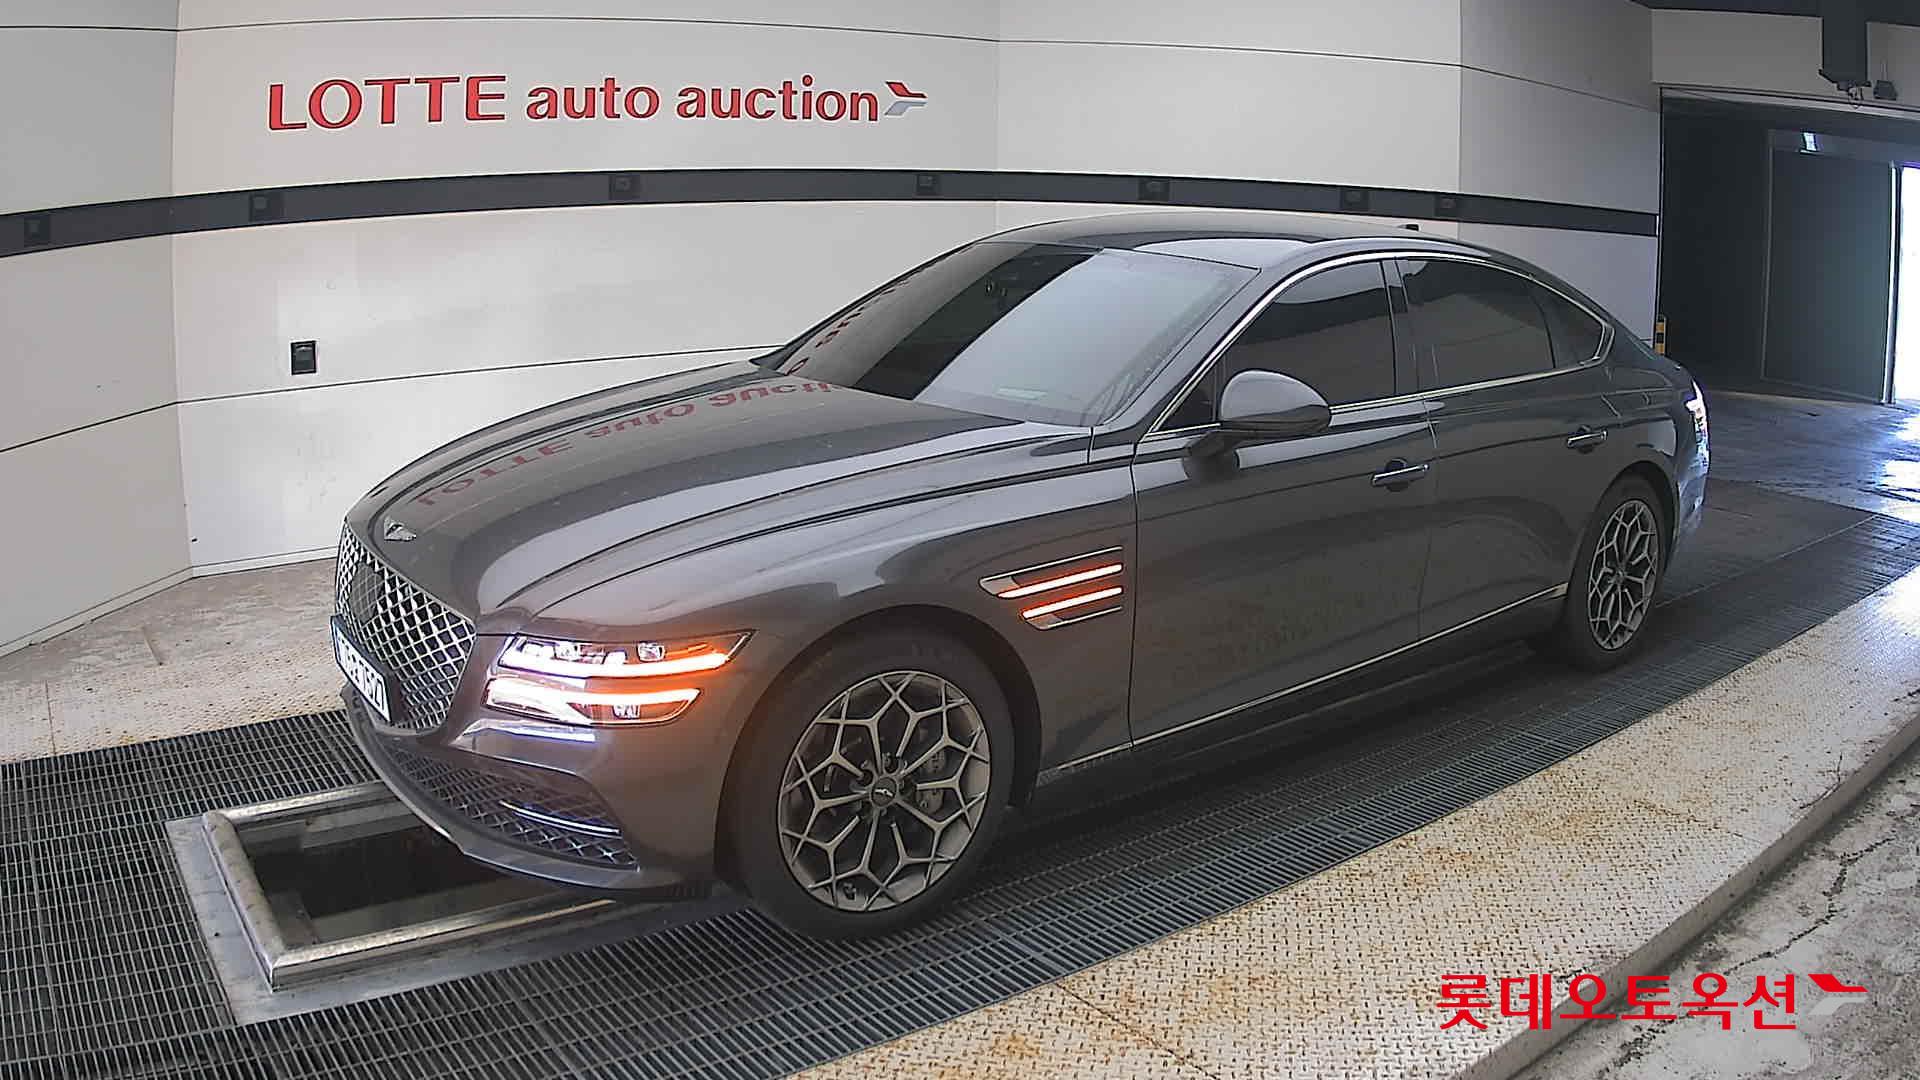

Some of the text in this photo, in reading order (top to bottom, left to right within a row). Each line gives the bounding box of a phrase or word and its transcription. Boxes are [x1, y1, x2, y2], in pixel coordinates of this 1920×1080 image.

[269, 74, 879, 131] LOTTE auto auction
